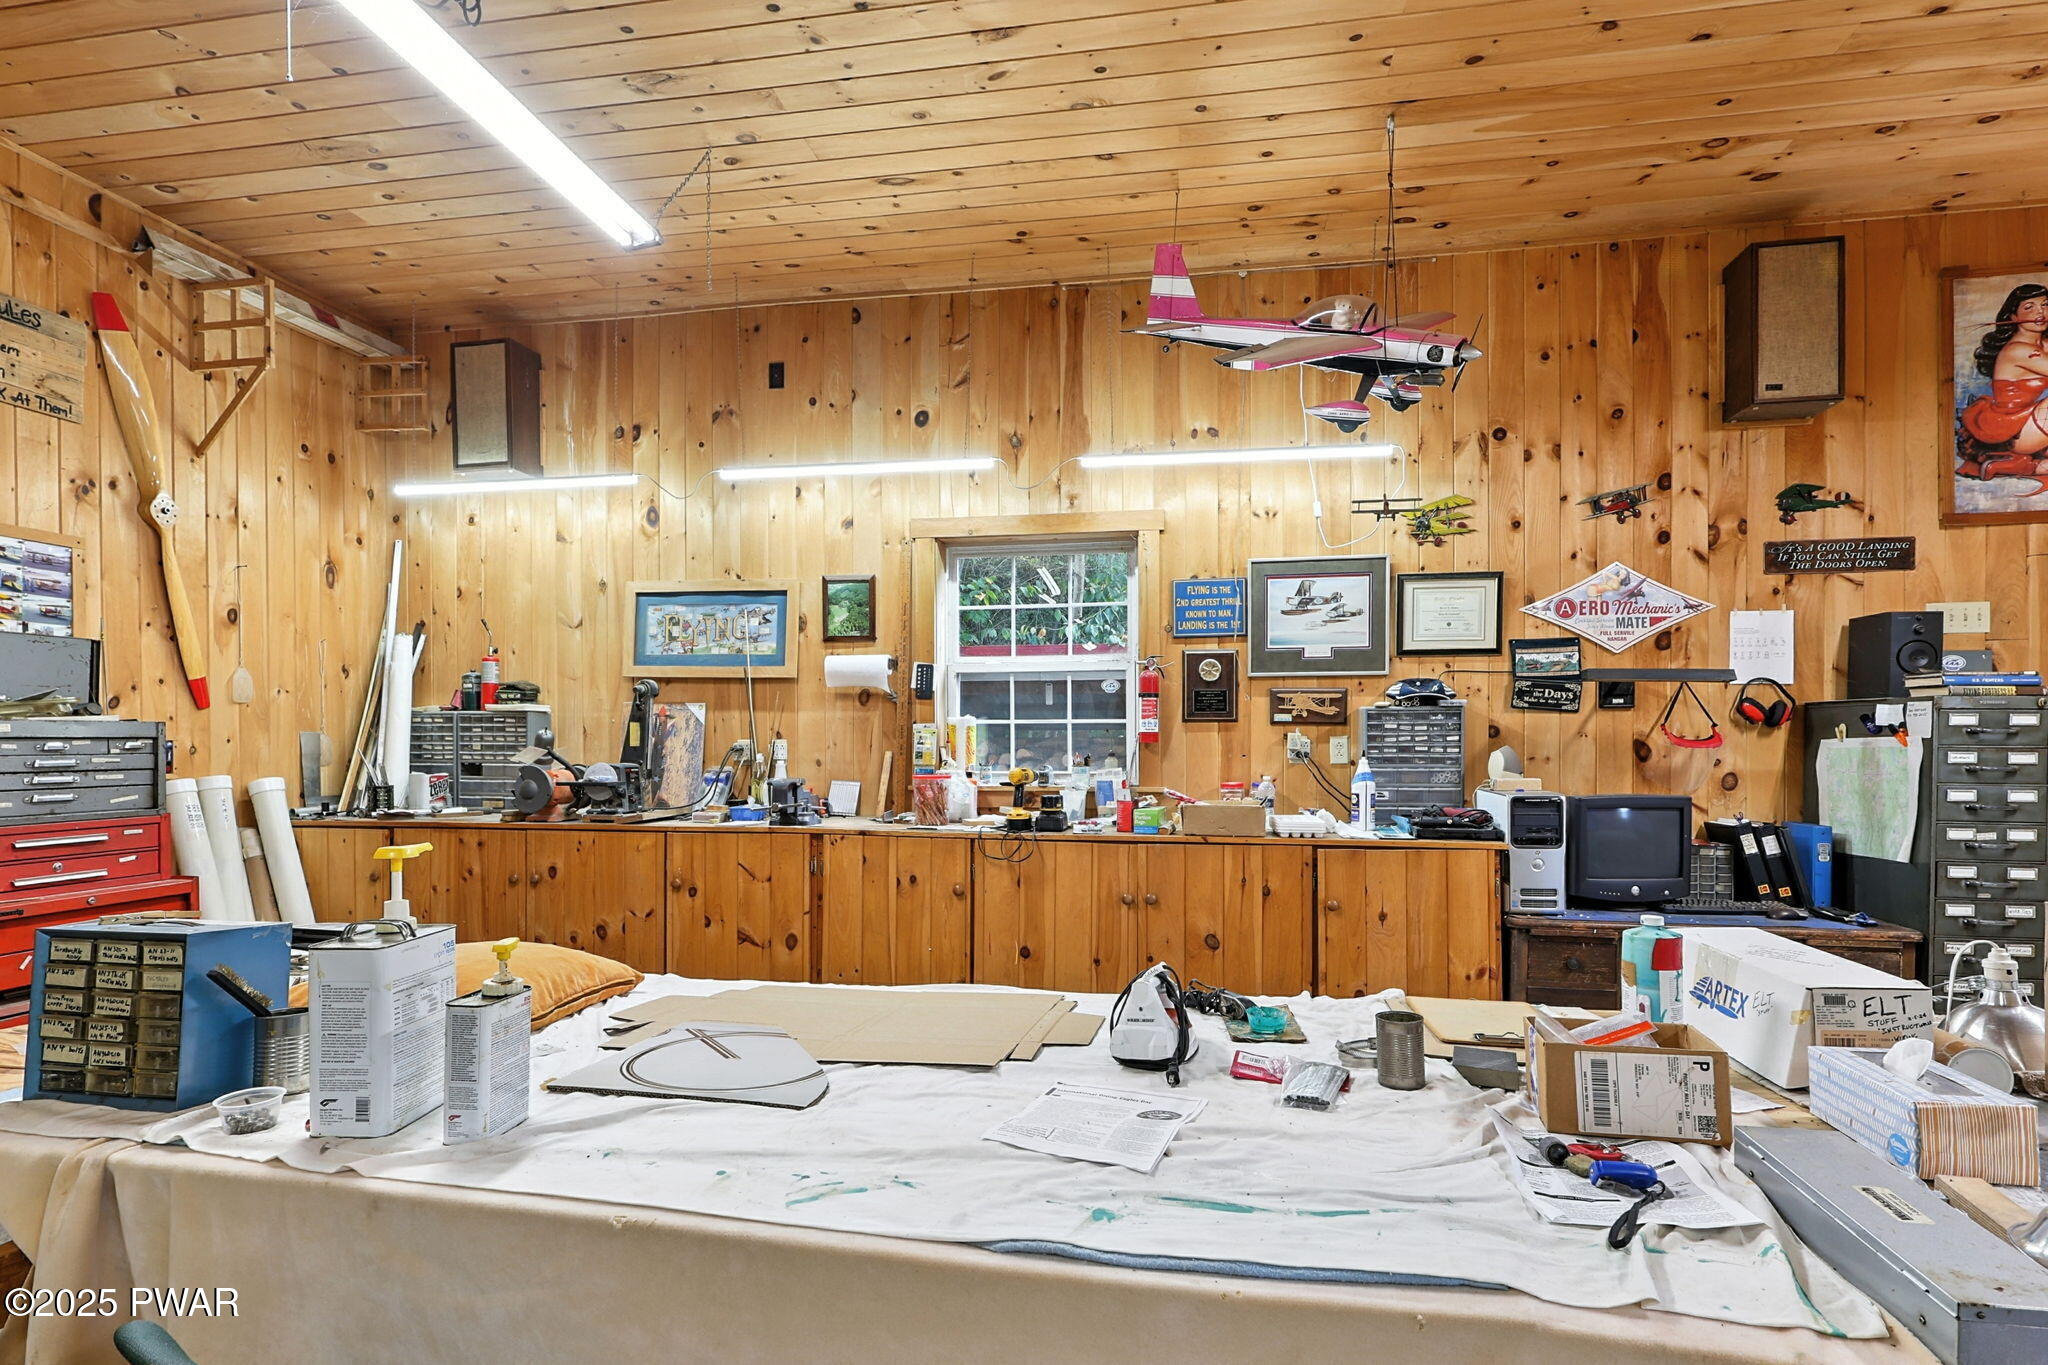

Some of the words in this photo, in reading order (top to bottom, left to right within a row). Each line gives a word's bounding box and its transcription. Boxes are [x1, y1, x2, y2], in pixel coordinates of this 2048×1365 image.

[1805, 543, 1814, 552] A
[1817, 542, 1855, 552] GOOD
[1858, 541, 1910, 551] LANDING
[1777, 553, 1789, 562] IF
[1793, 552, 1814, 561] YOU
[1817, 551, 1840, 560] CAN
[1843, 550, 1874, 560] STILL
[1877, 550, 1900, 559] GET
[1789, 561, 1812, 570] THE
[1815, 560, 1852, 569] DOORS
[1855, 559, 1888, 568] OPEN.
[1187, 585, 1210, 595] FLYING
[1211, 586, 1218, 594] IS
[1219, 586, 1231, 594] THE
[1176, 598, 1189, 607] 2ND
[1191, 598, 1220, 607] GREATEST
[1558, 599, 1610, 617] AERO
[1612, 599, 1681, 617] Mechanic's
[1185, 610, 1207, 618] KNOWN
[1208, 610, 1216, 618] TO
[1218, 609, 1233, 617] MAN.
[1178, 621, 1207, 630] LANDING
[1216, 621, 1228, 629] THE
[1615, 616, 1648, 629] MATE
[663, 613, 748, 647] FLYING
[1544, 688, 1574, 701] Days
[1704, 977, 1749, 1018] ARTEX
[1752, 990, 1775, 1009] ELT
[1863, 994, 1912, 1017] ELT
[1867, 1017, 1898, 1027] STUFF
[1693, 1061, 1710, 1072] P
